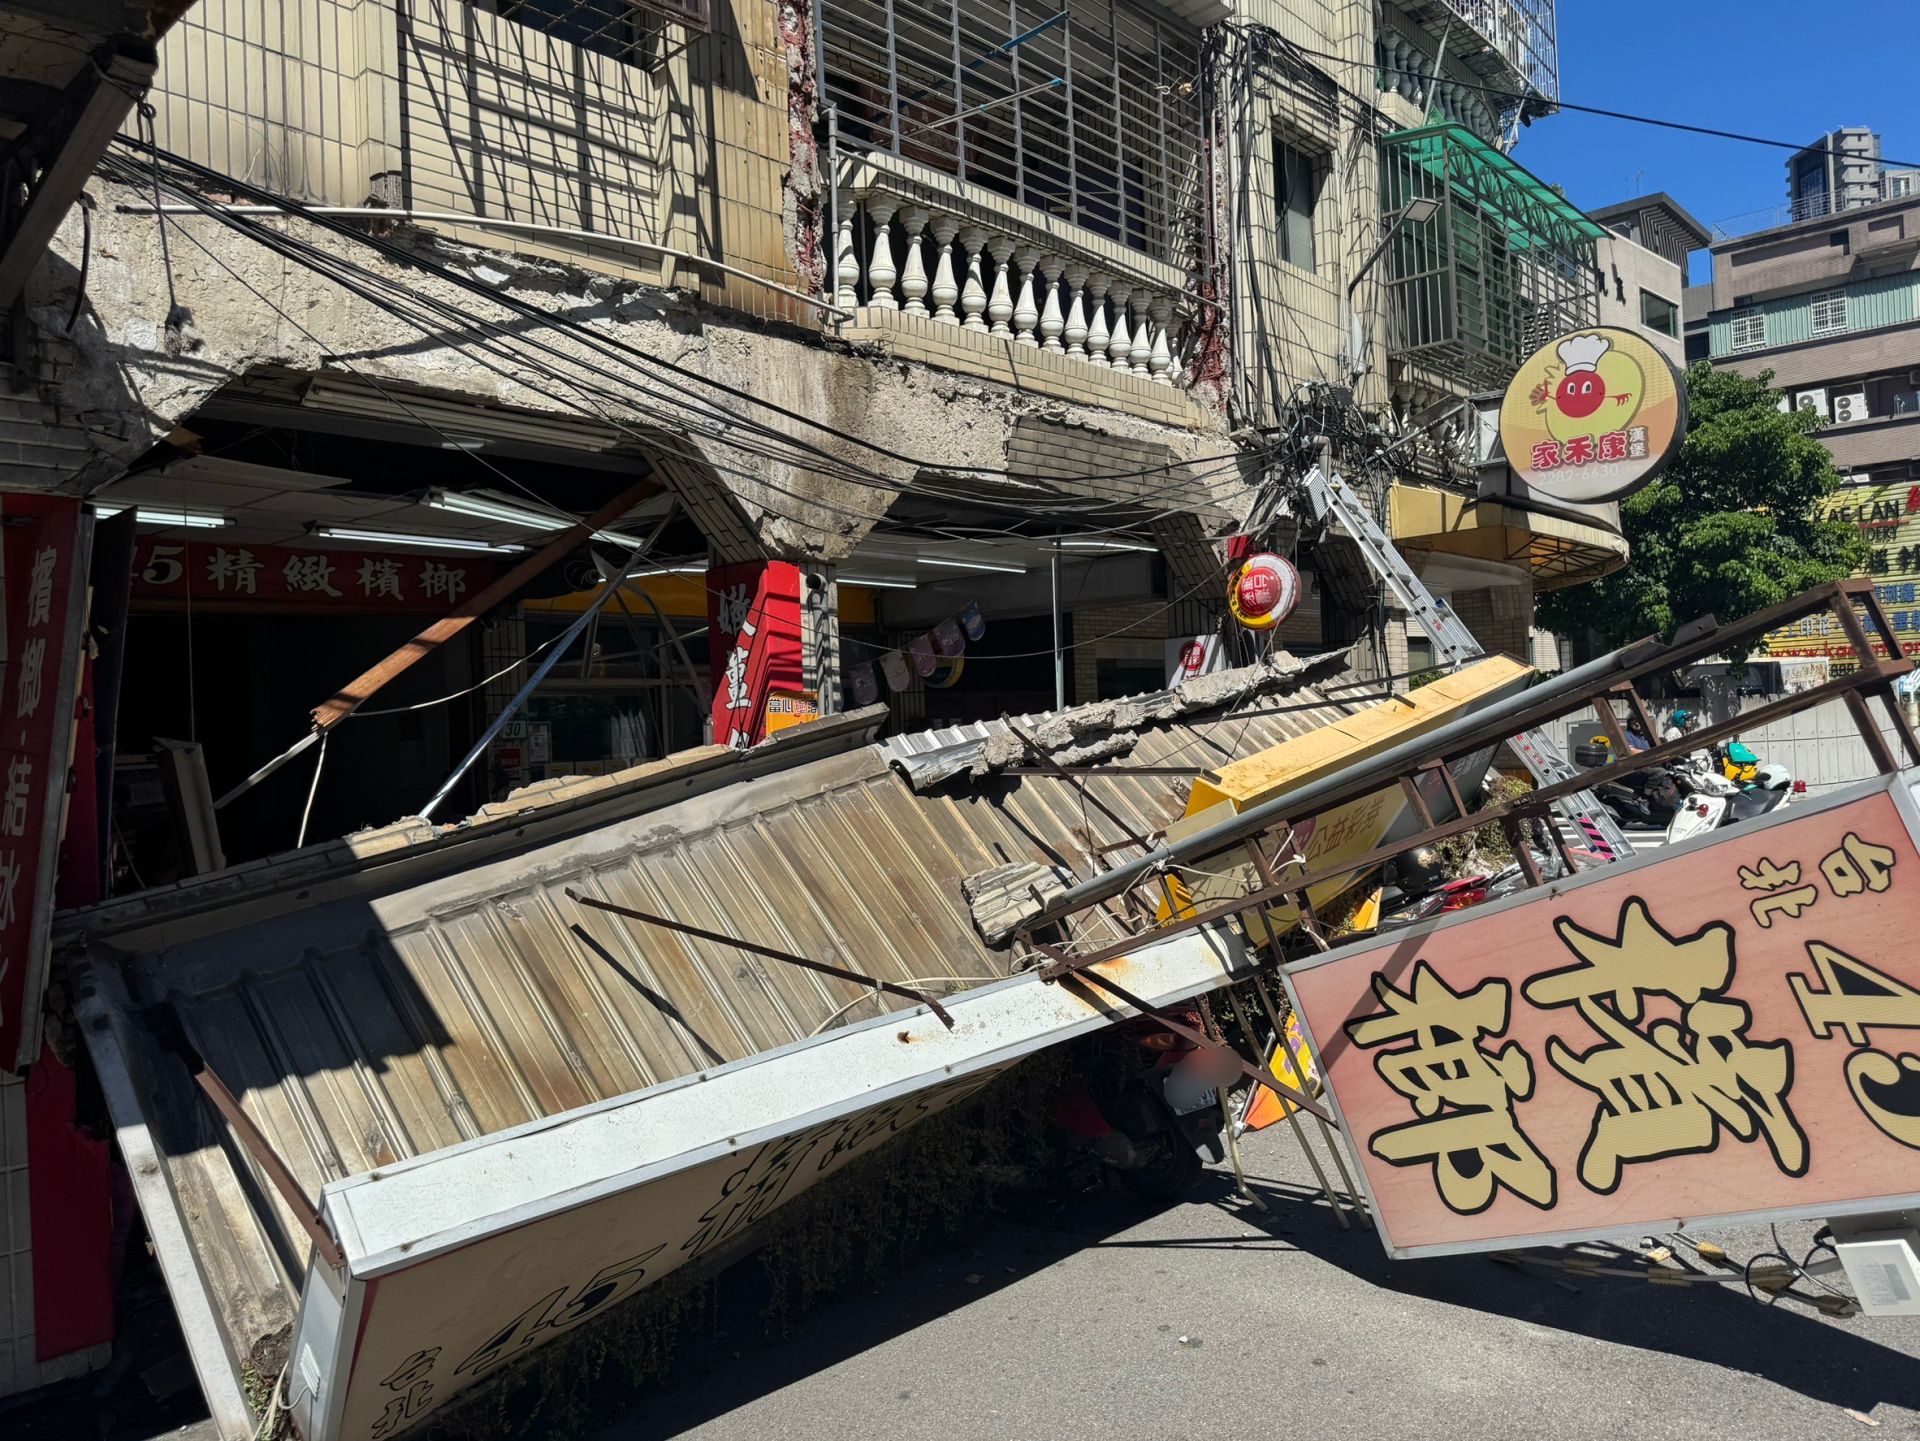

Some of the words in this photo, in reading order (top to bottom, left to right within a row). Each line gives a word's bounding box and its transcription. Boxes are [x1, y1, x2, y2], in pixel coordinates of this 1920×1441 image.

[1531, 430, 1627, 469] 家禾康
[1538, 463, 1618, 485] 2282-6630
[1629, 427, 1646, 458] 漢堡
[1858, 499, 1900, 522] LAN
[1306, 792, 1386, 862] 公益彩券
[1737, 831, 1897, 929] 台北
[1343, 895, 1811, 1214] 檳榔
[453, 1242, 668, 1376] 45
[371, 1346, 442, 1440] 台北
